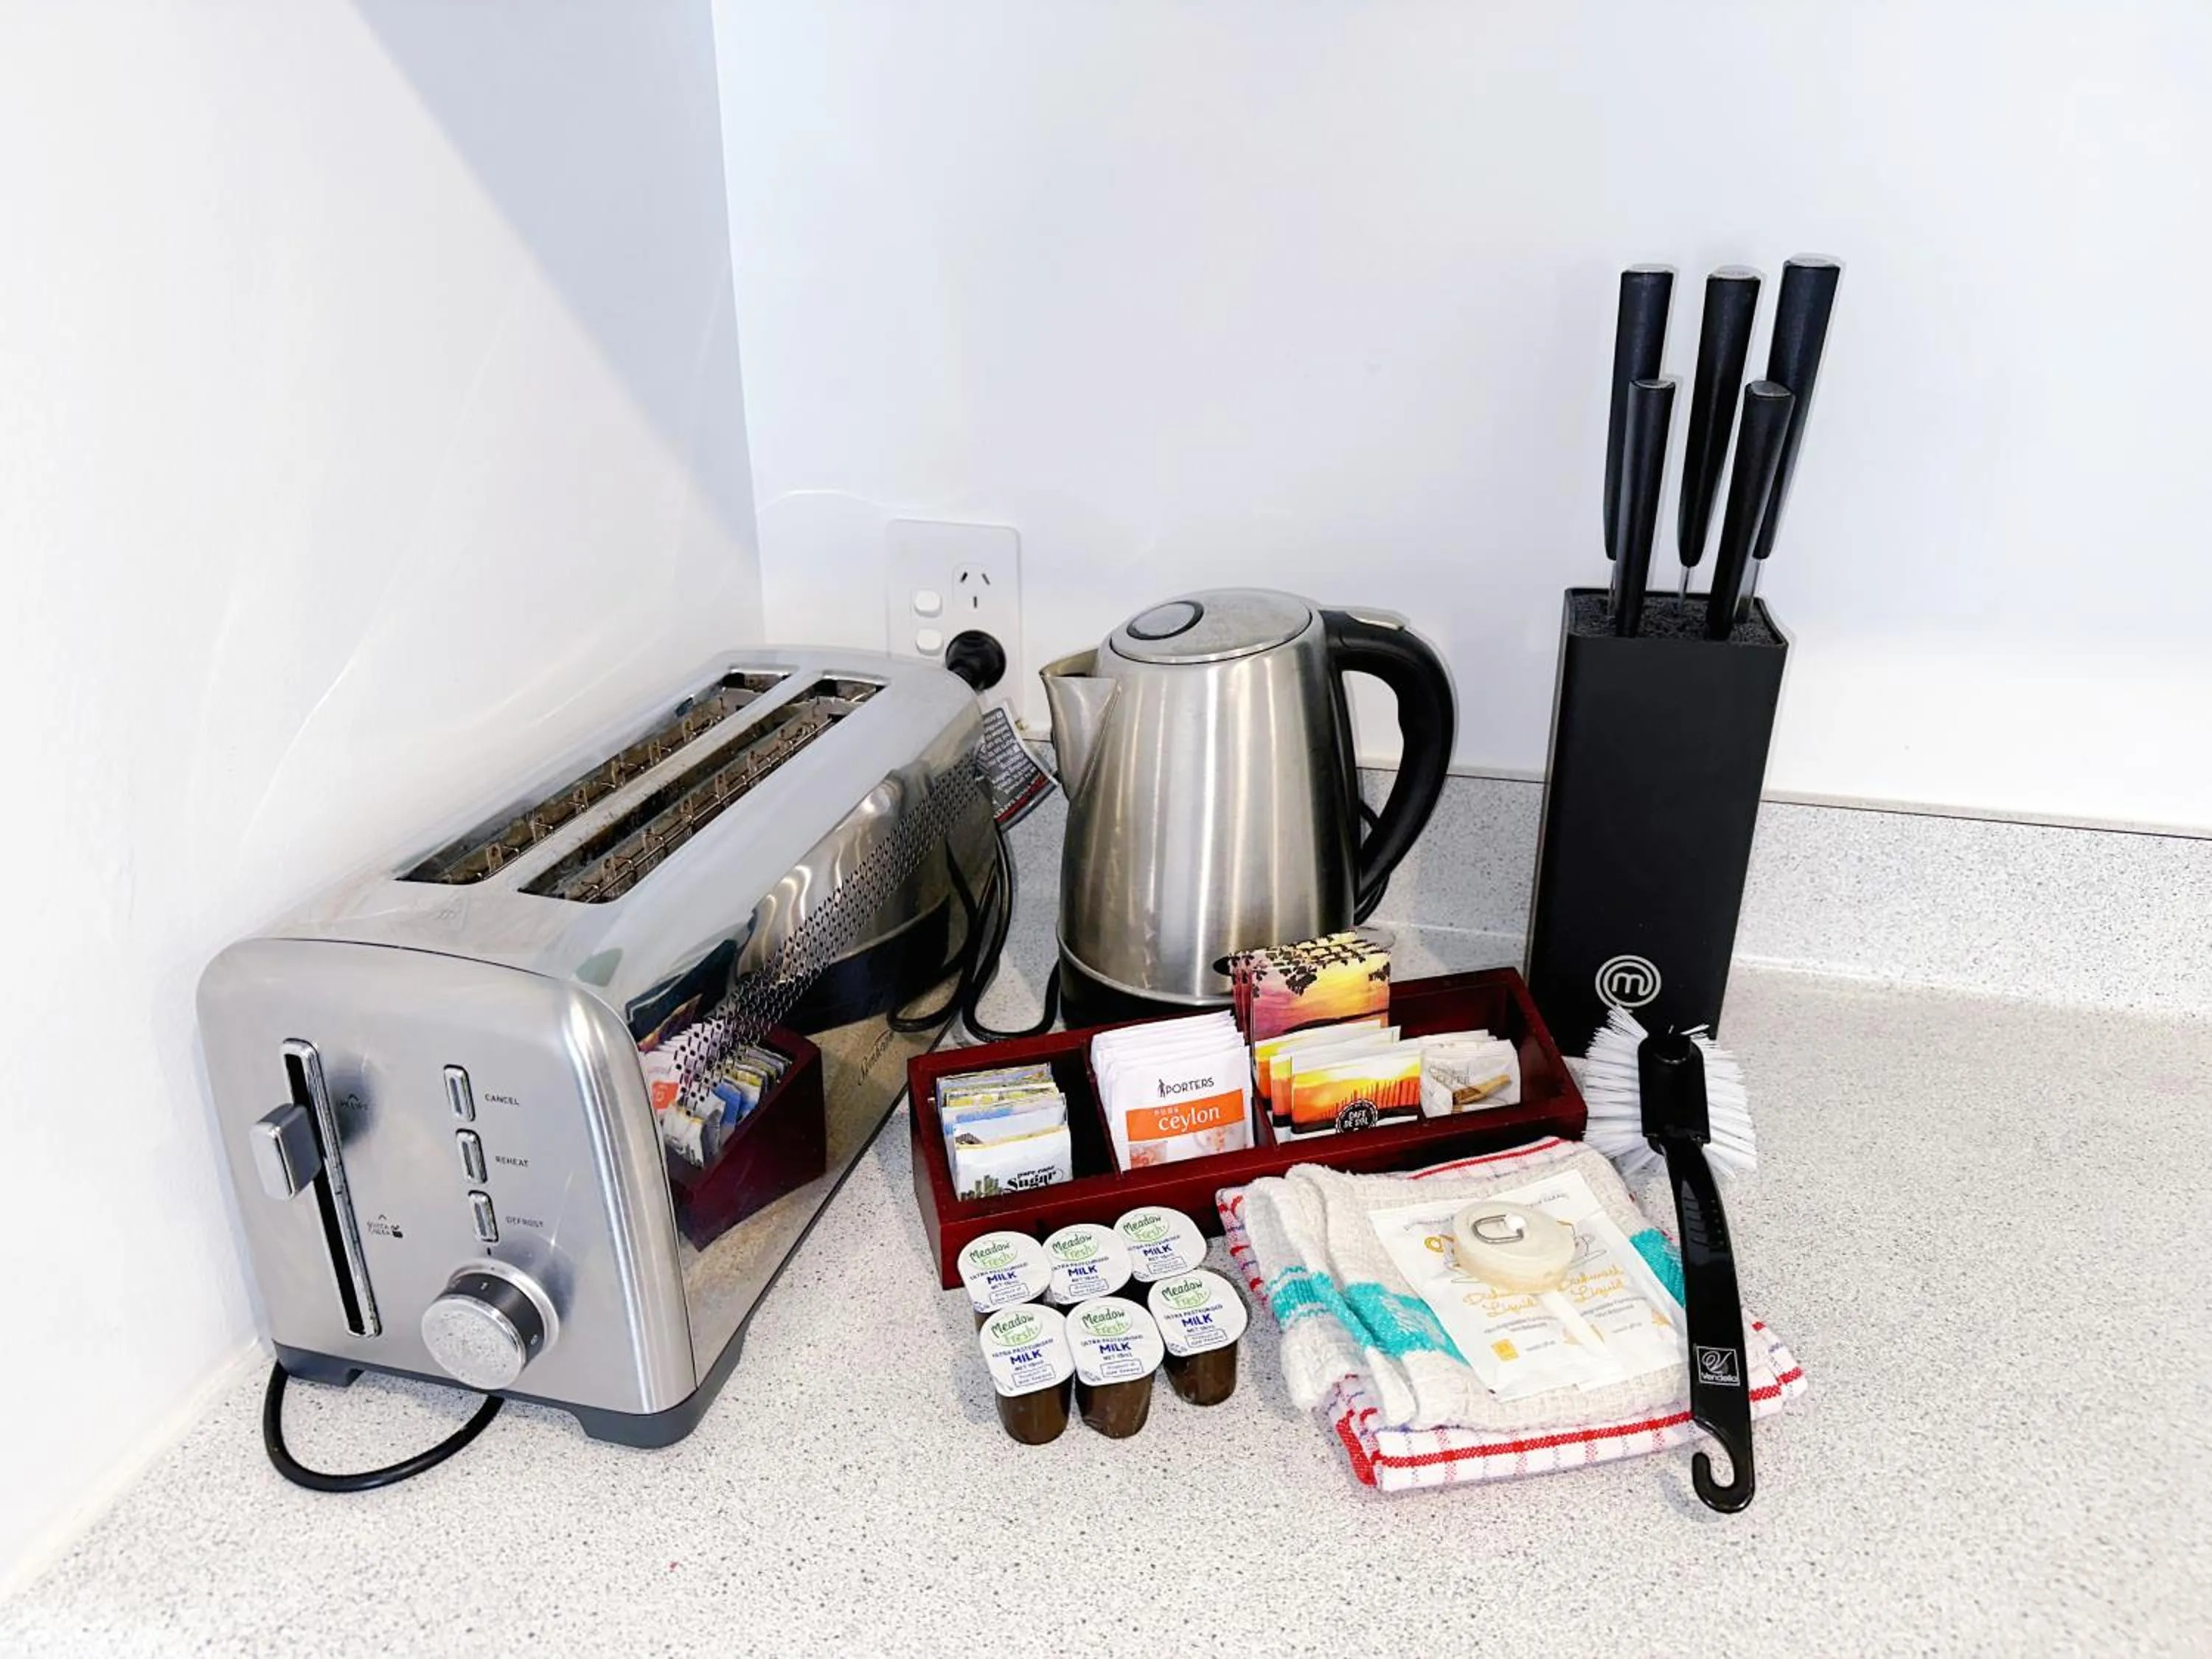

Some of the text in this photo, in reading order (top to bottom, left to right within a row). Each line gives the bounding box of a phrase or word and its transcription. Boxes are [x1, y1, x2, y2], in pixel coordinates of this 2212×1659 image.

[1165, 1077, 1214, 1096] PORTERS
[484, 1093, 520, 1106] CANCEL
[1158, 1107, 1220, 1133] ceylon
[495, 1155, 529, 1167] REHEAT
[1006, 1170, 1057, 1192] Sugar
[505, 1216, 544, 1228] DEFROST
[1123, 1215, 1161, 1236] Meadow
[970, 1240, 1009, 1262] Meadow
[1052, 1233, 1092, 1253] Meadow
[1143, 1245, 1172, 1256] MILK
[987, 1271, 1017, 1284] MILK
[1068, 1265, 1098, 1277] MILK
[1161, 1279, 1203, 1301] Meadow
[990, 1313, 1034, 1338] Meadow
[1081, 1308, 1124, 1329] Meadow
[1181, 1313, 1213, 1327] MILK
[1099, 1341, 1132, 1354] MILK
[1009, 1349, 1042, 1365] MILK
